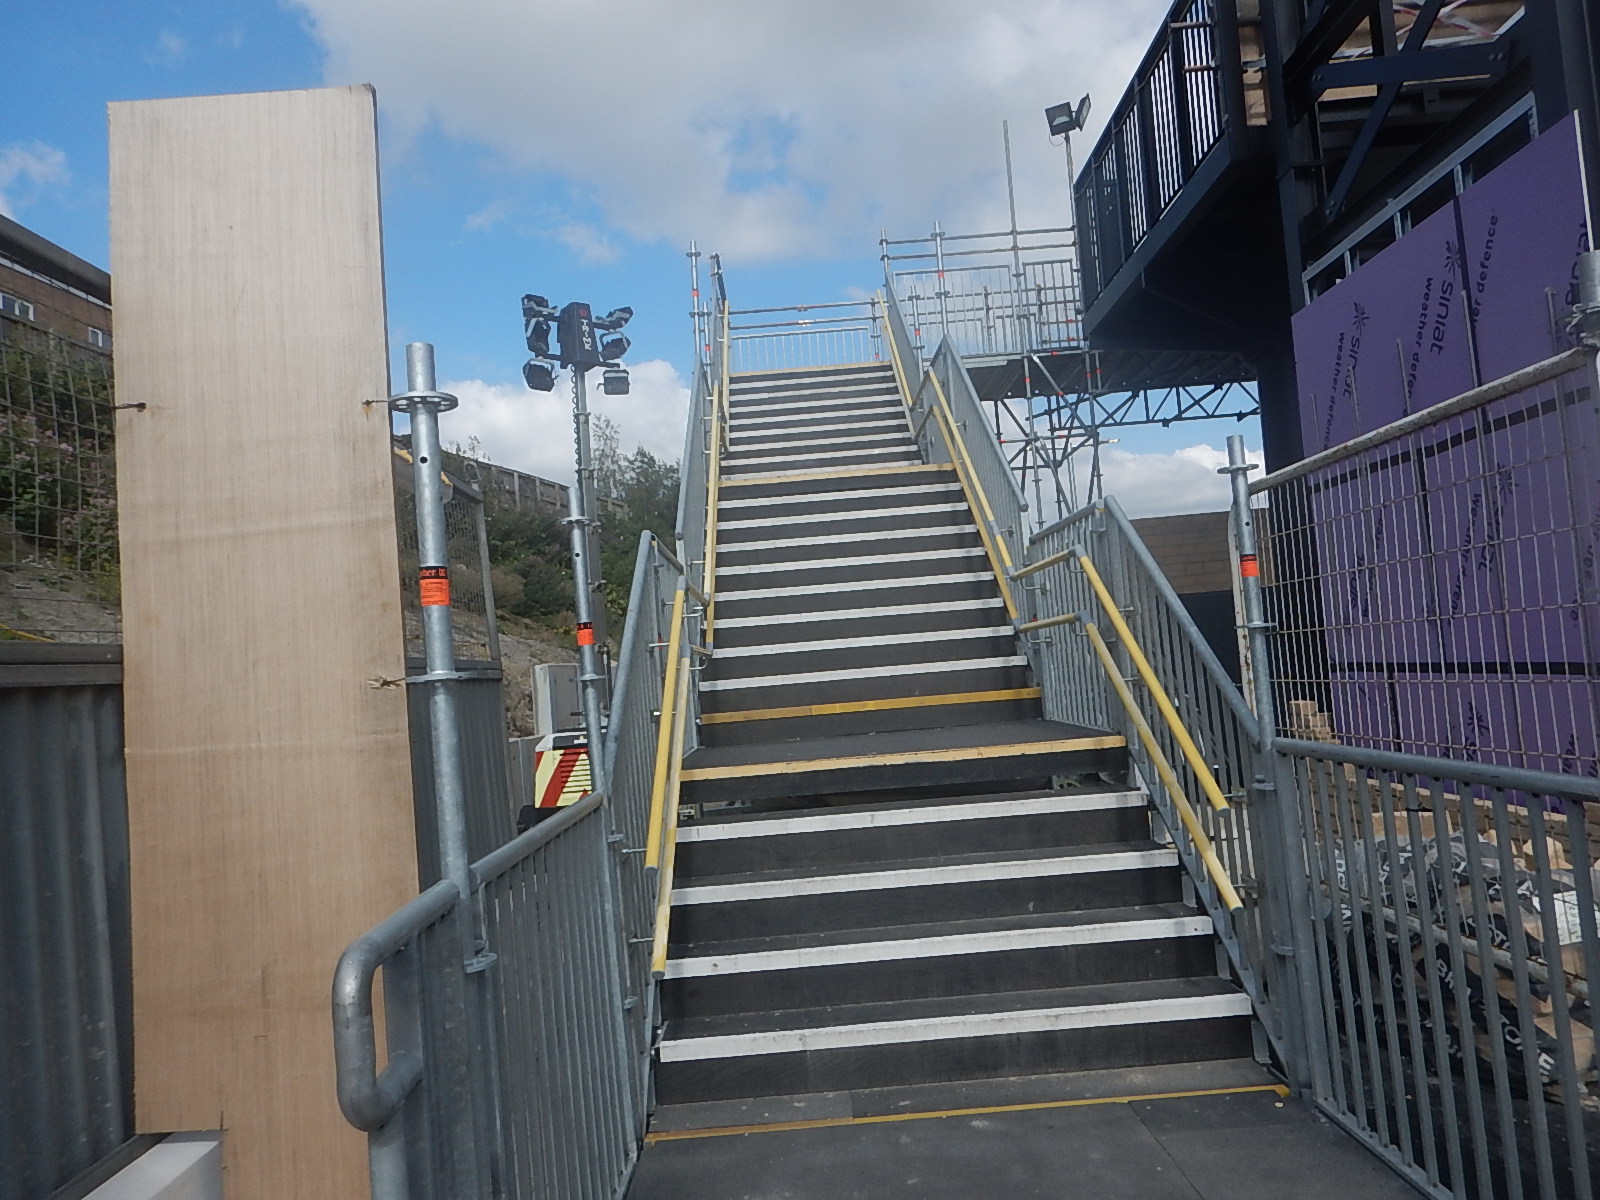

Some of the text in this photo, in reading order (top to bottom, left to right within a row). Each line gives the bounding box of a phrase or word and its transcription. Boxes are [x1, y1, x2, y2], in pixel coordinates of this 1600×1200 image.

[1477, 215, 1498, 294] defence
[1415, 277, 1433, 348] weather
[1430, 280, 1454, 355] siniat
[1332, 332, 1345, 393] weather
